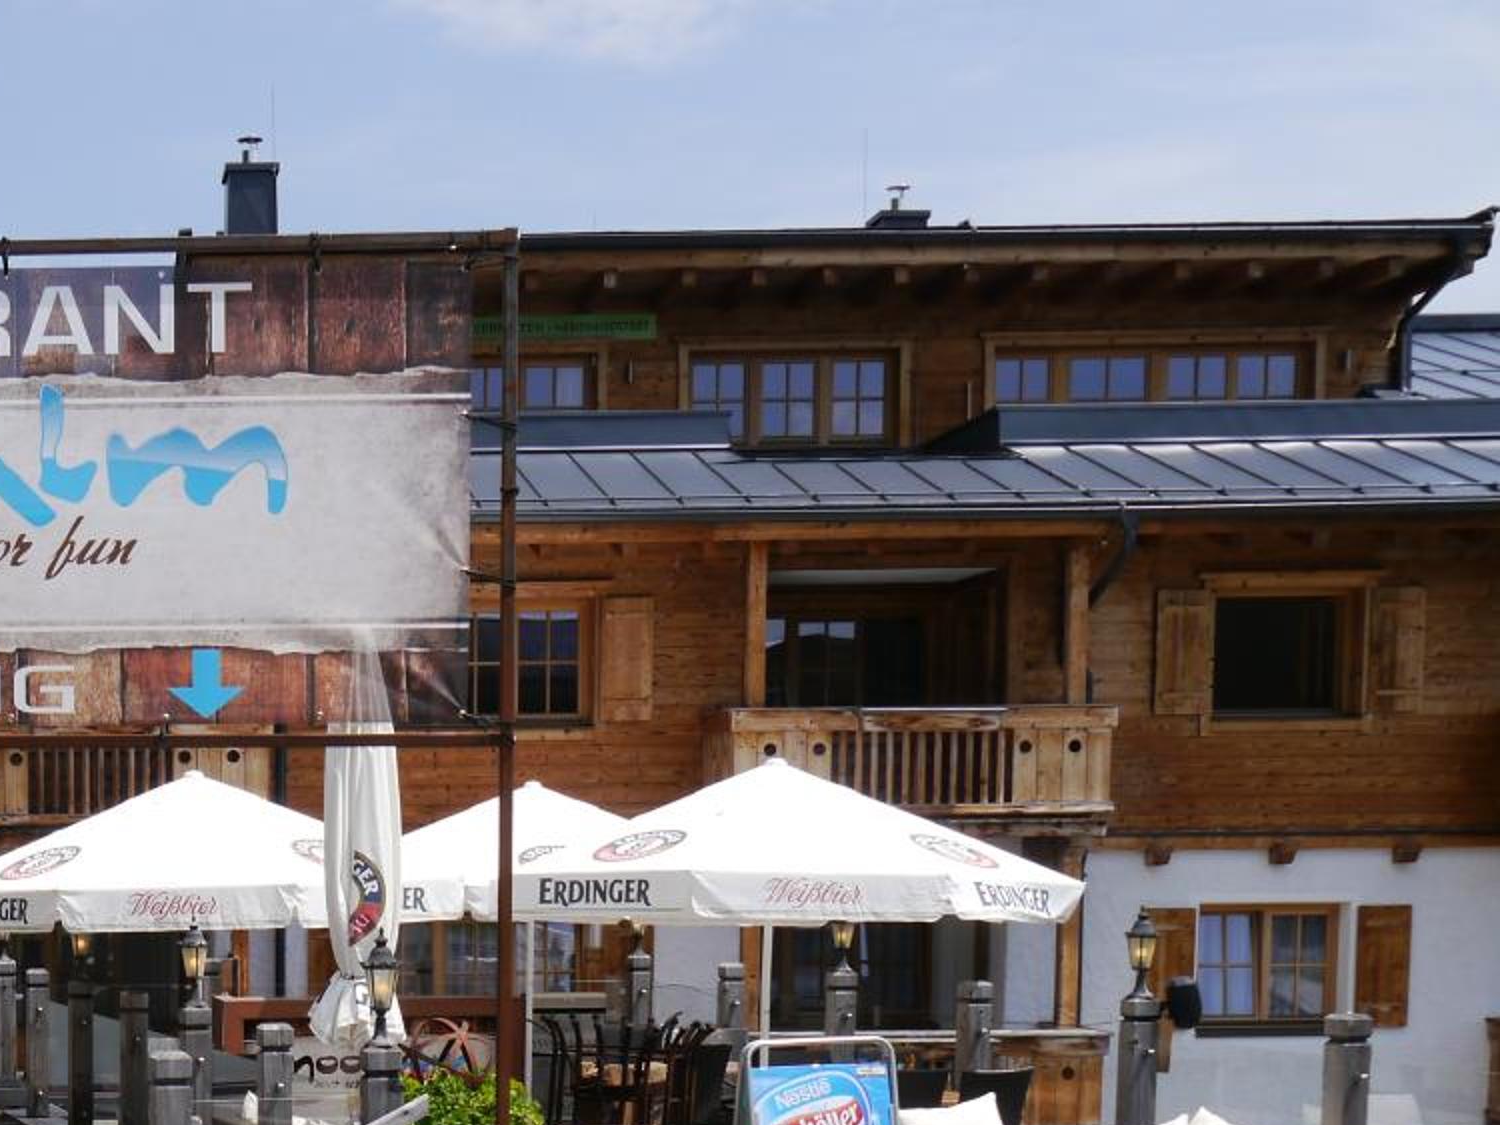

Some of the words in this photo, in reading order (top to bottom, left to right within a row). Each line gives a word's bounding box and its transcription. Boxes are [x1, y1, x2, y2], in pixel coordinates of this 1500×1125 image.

[44, 515, 138, 580] fun
[539, 877, 652, 907] ERDINGER
[973, 881, 1050, 913] ERDINGER
